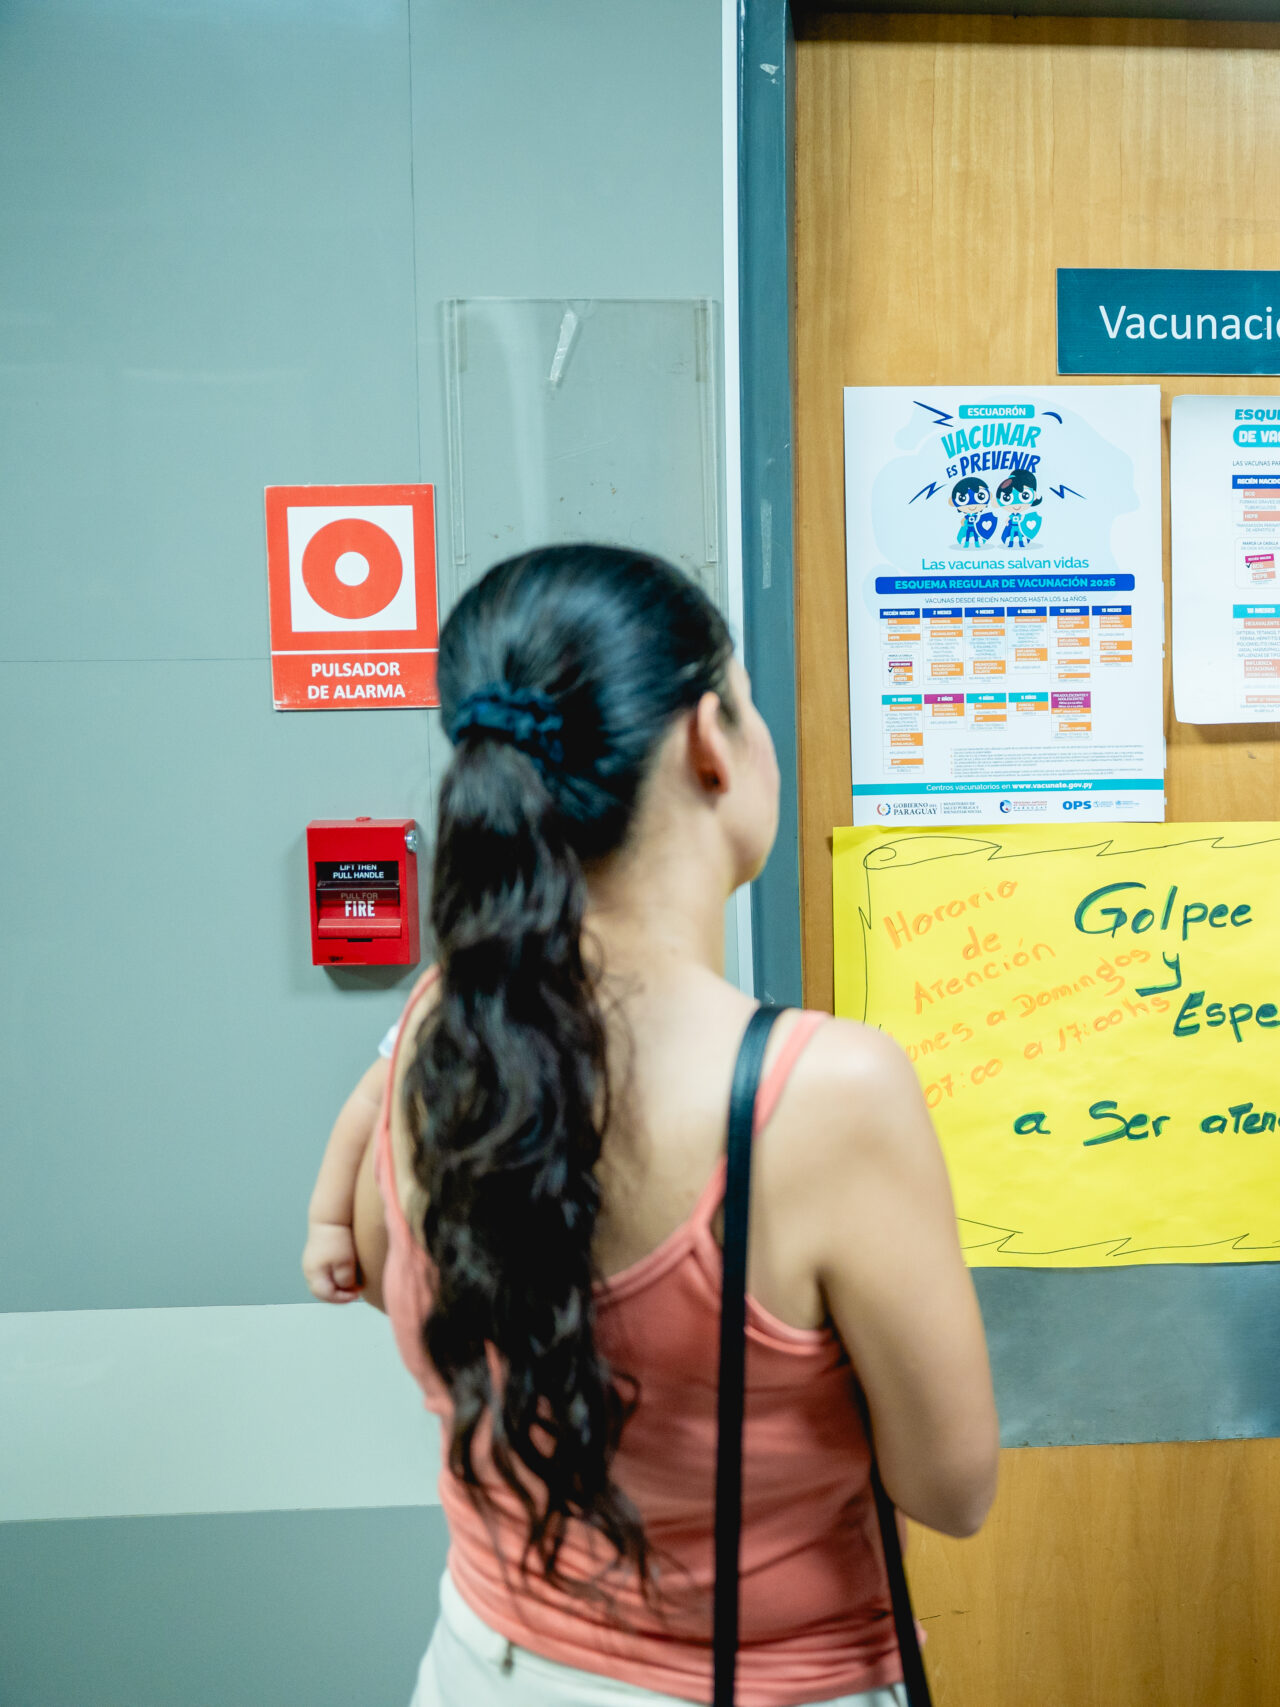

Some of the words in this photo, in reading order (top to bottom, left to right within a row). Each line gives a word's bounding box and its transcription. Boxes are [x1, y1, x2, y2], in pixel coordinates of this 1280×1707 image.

[967, 405, 1026, 417] ESCUADRÓN
[941, 422, 1042, 459] VACUNAR
[1238, 430, 1256, 443] DE
[946, 465, 958, 479] ES
[960, 450, 1041, 477] PREVENIR
[922, 558, 945, 571] Las
[948, 560, 1004, 570] vacunas
[1008, 557, 1050, 569] salvan
[1054, 557, 1089, 569] vidas
[895, 580, 947, 591] ESQUEMA
[950, 579, 1000, 589] REGULAR
[1002, 579, 1015, 588] DE
[1017, 577, 1088, 589] VACUNACIÓN
[1090, 578, 1116, 588] 2026
[311, 662, 400, 677] PULSADOR
[307, 685, 329, 699] DE
[333, 684, 405, 699] ALARMA
[955, 783, 1000, 791] vacunatorios
[1062, 800, 1092, 810] OPS
[345, 901, 375, 917] FIRE
[883, 880, 1018, 951] Horario
[1074, 881, 1253, 941] Golpee
[962, 926, 1003, 961] de
[1135, 951, 1182, 997] y
[888, 1023, 974, 1064] unes
[986, 1009, 1006, 1027] a
[1012, 949, 1151, 1018] Domingos
[925, 1058, 1003, 1110] 07:00
[1023, 1041, 1044, 1060] a
[1013, 1111, 1051, 1136] a
[1083, 1100, 1171, 1147] Ser
